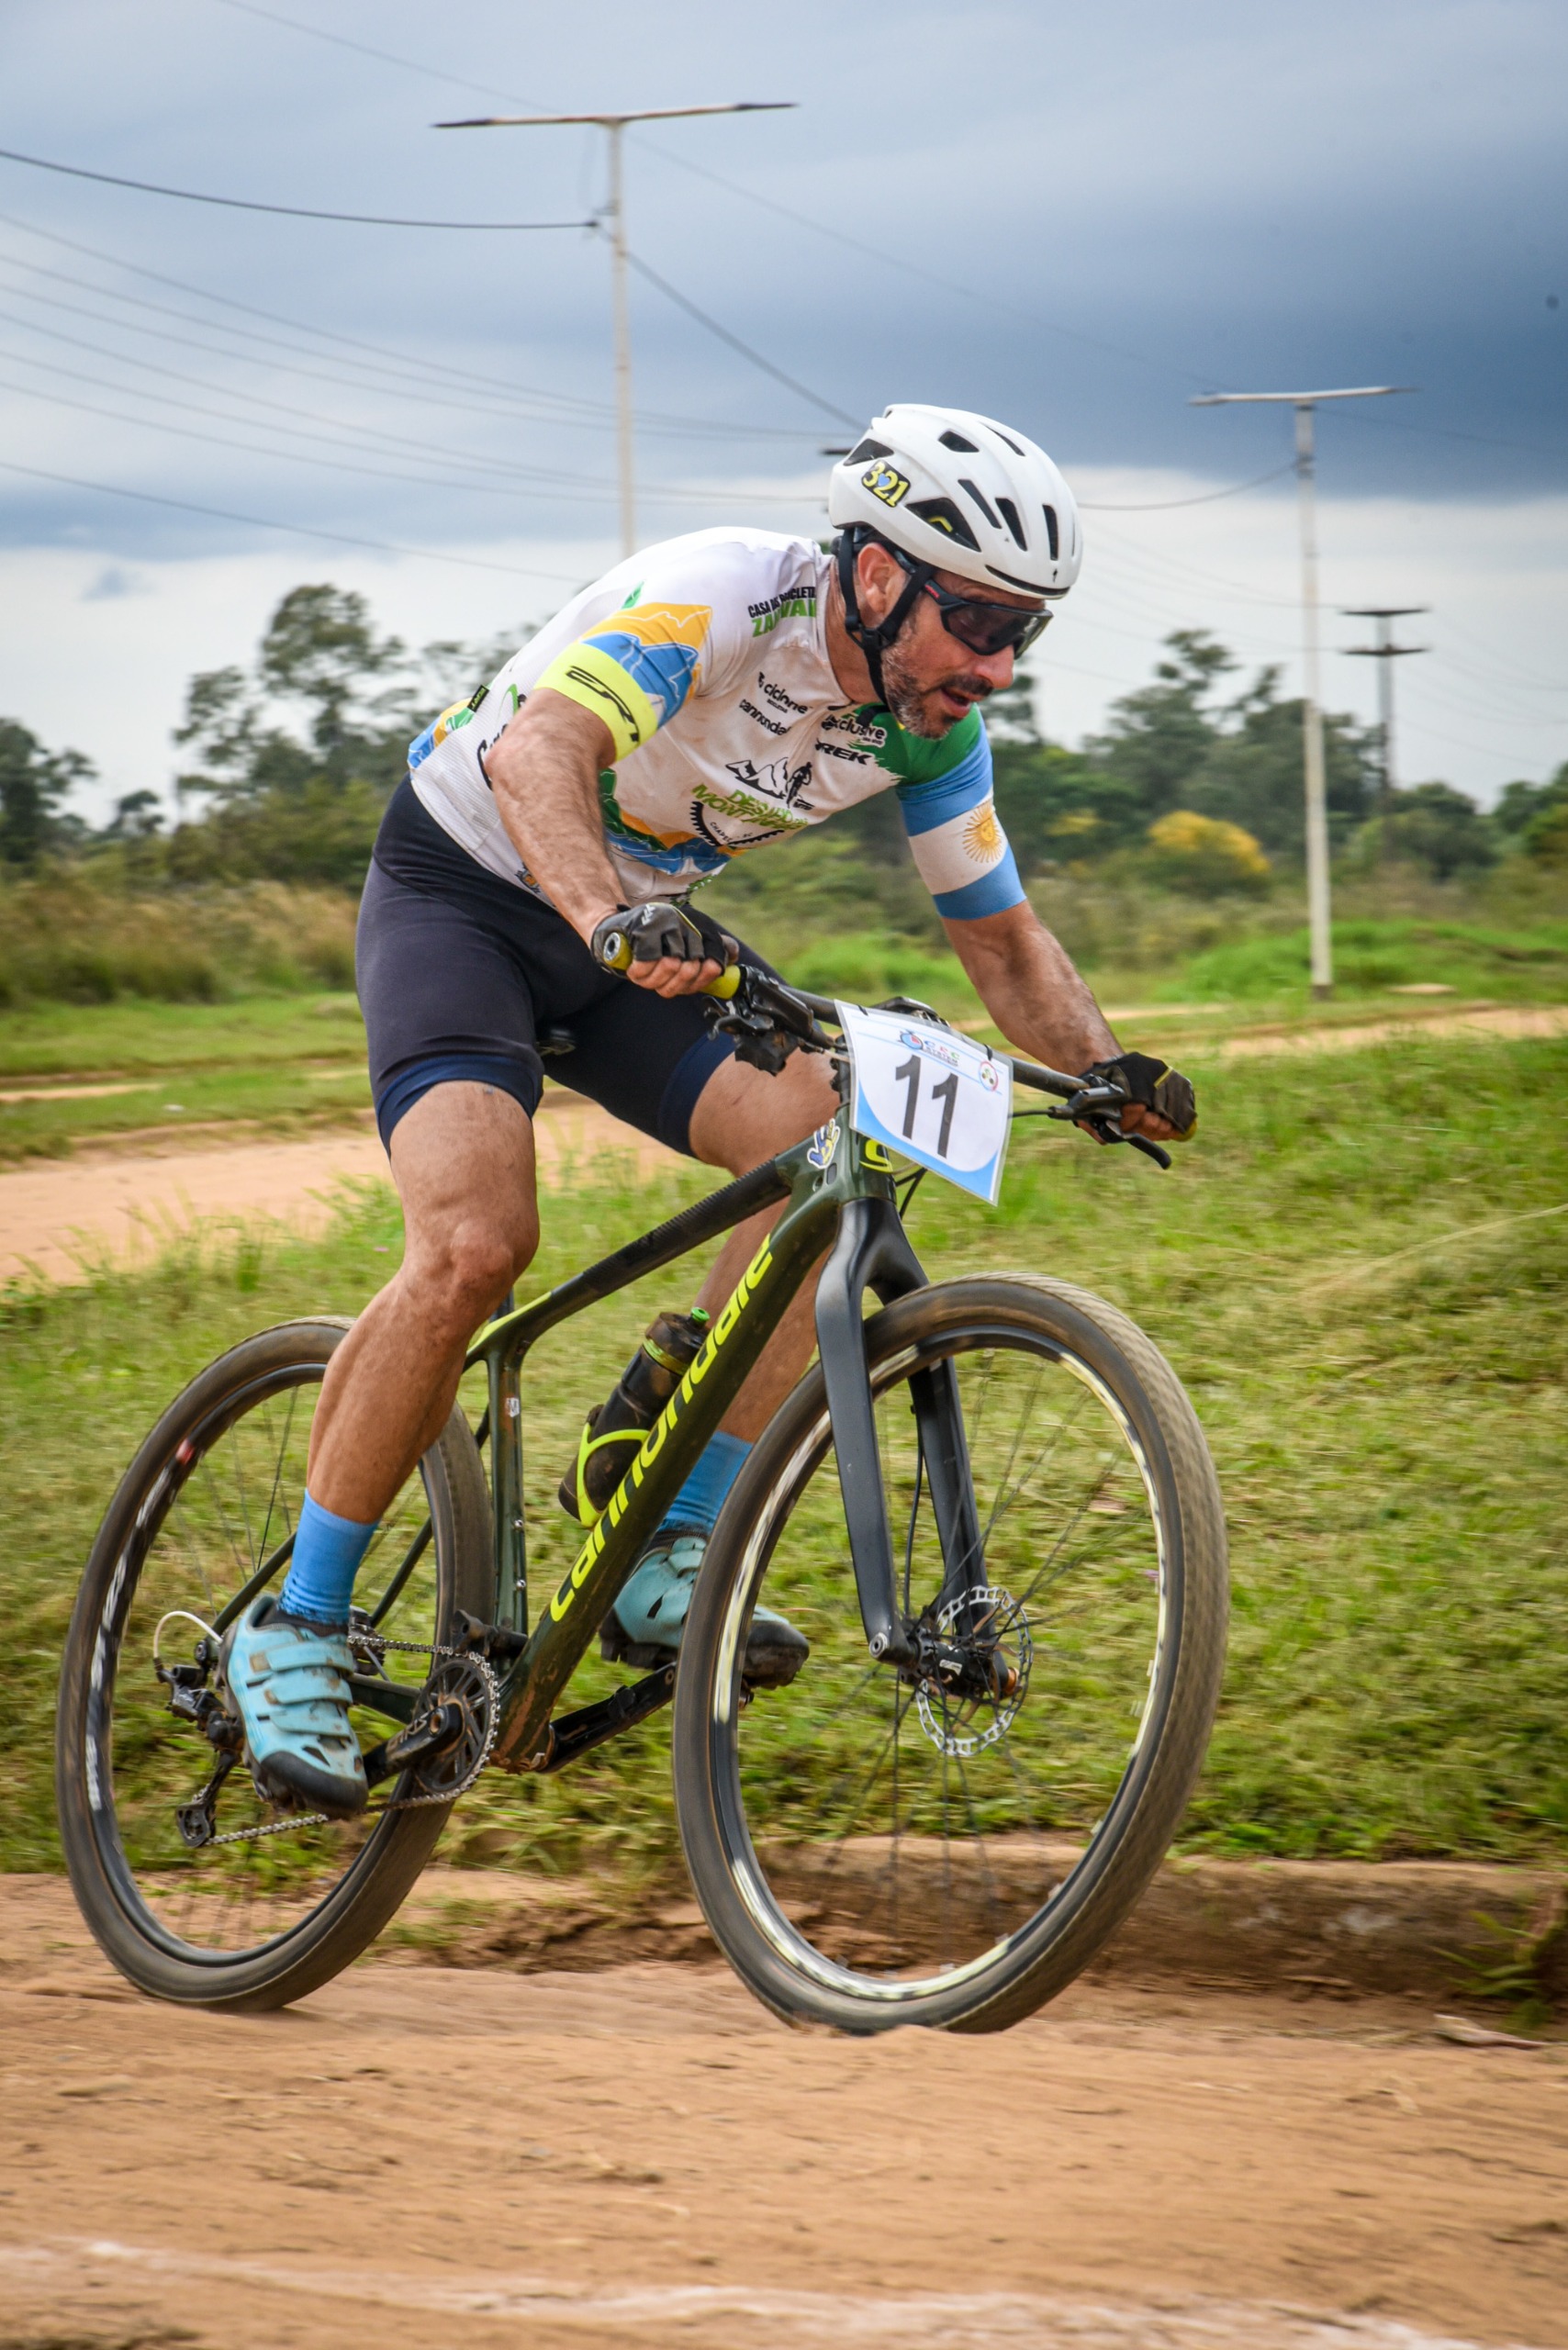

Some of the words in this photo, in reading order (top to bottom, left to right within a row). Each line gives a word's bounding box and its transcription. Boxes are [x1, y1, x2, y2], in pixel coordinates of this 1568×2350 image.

[863, 461, 909, 508] 321
[748, 600, 771, 619] CASA
[895, 1054, 958, 1158] 11
[550, 1233, 773, 1622] cannondale
